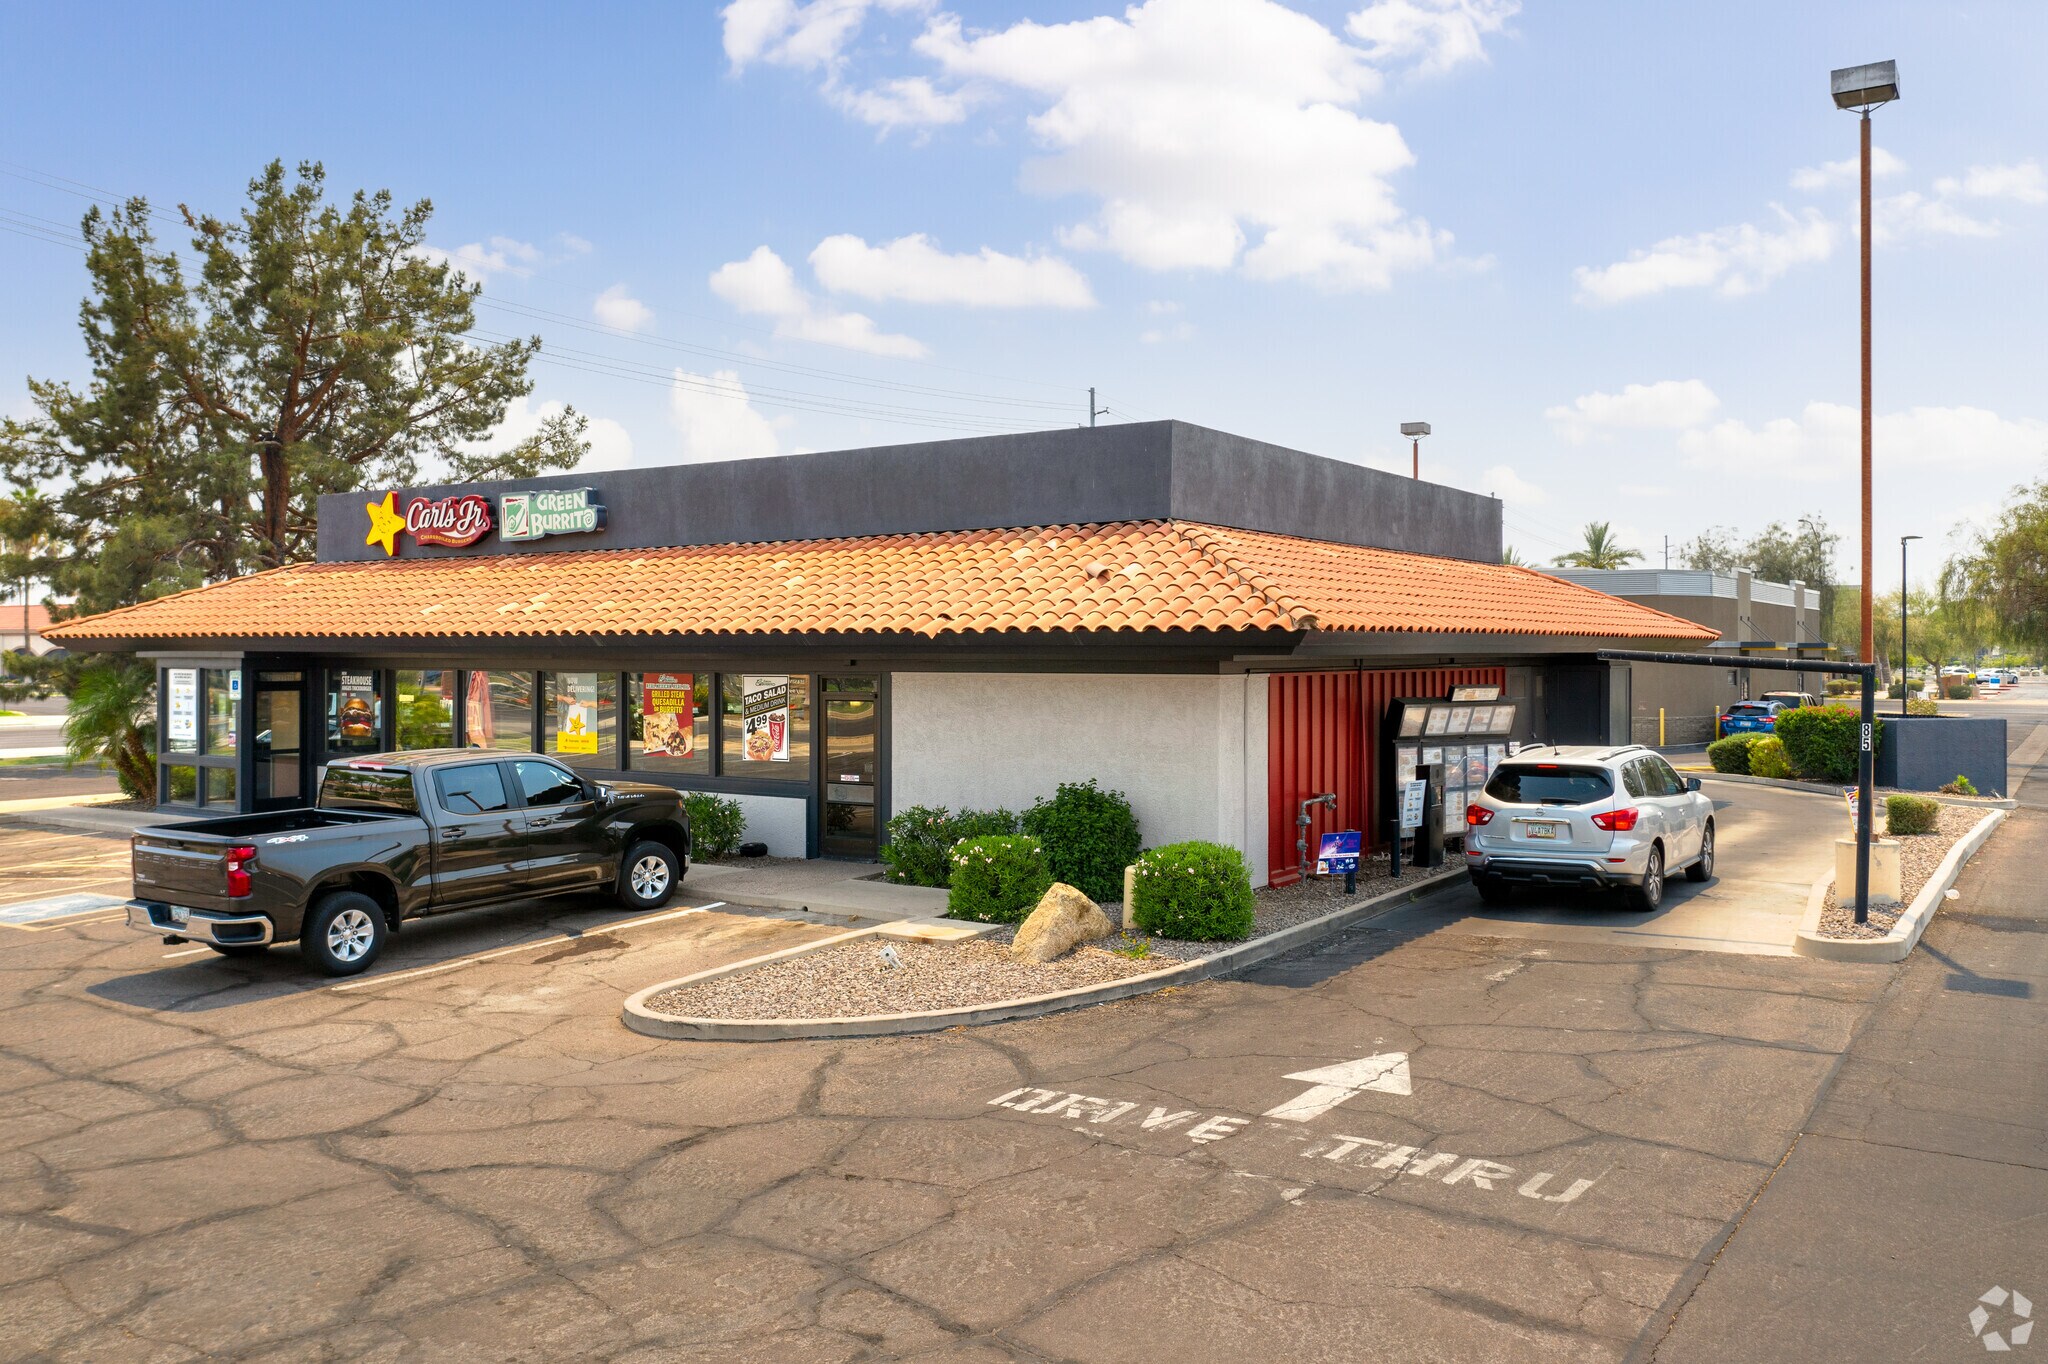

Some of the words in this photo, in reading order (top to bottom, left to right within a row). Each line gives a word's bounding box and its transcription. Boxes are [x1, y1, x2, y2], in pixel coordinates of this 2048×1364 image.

[536, 491, 586, 511] GREEN
[407, 500, 457, 532] Carl's
[456, 500, 487, 531] Jr.
[530, 508, 595, 536] BURRITO
[341, 675, 372, 685] STEAKHOUSE
[651, 690, 669, 698] GRILLED
[670, 690, 685, 699] STEAK
[651, 698, 685, 706] QUESADILLA
[744, 693, 762, 705] TACO
[763, 685, 787, 699] SALAD
[749, 702, 770, 713] MEDIUM
[770, 696, 786, 707] DRINK
[659, 705, 683, 714] BURRITO
[986, 1087, 1251, 1145] DRIVE
[1323, 1134, 1596, 1203] THRU
